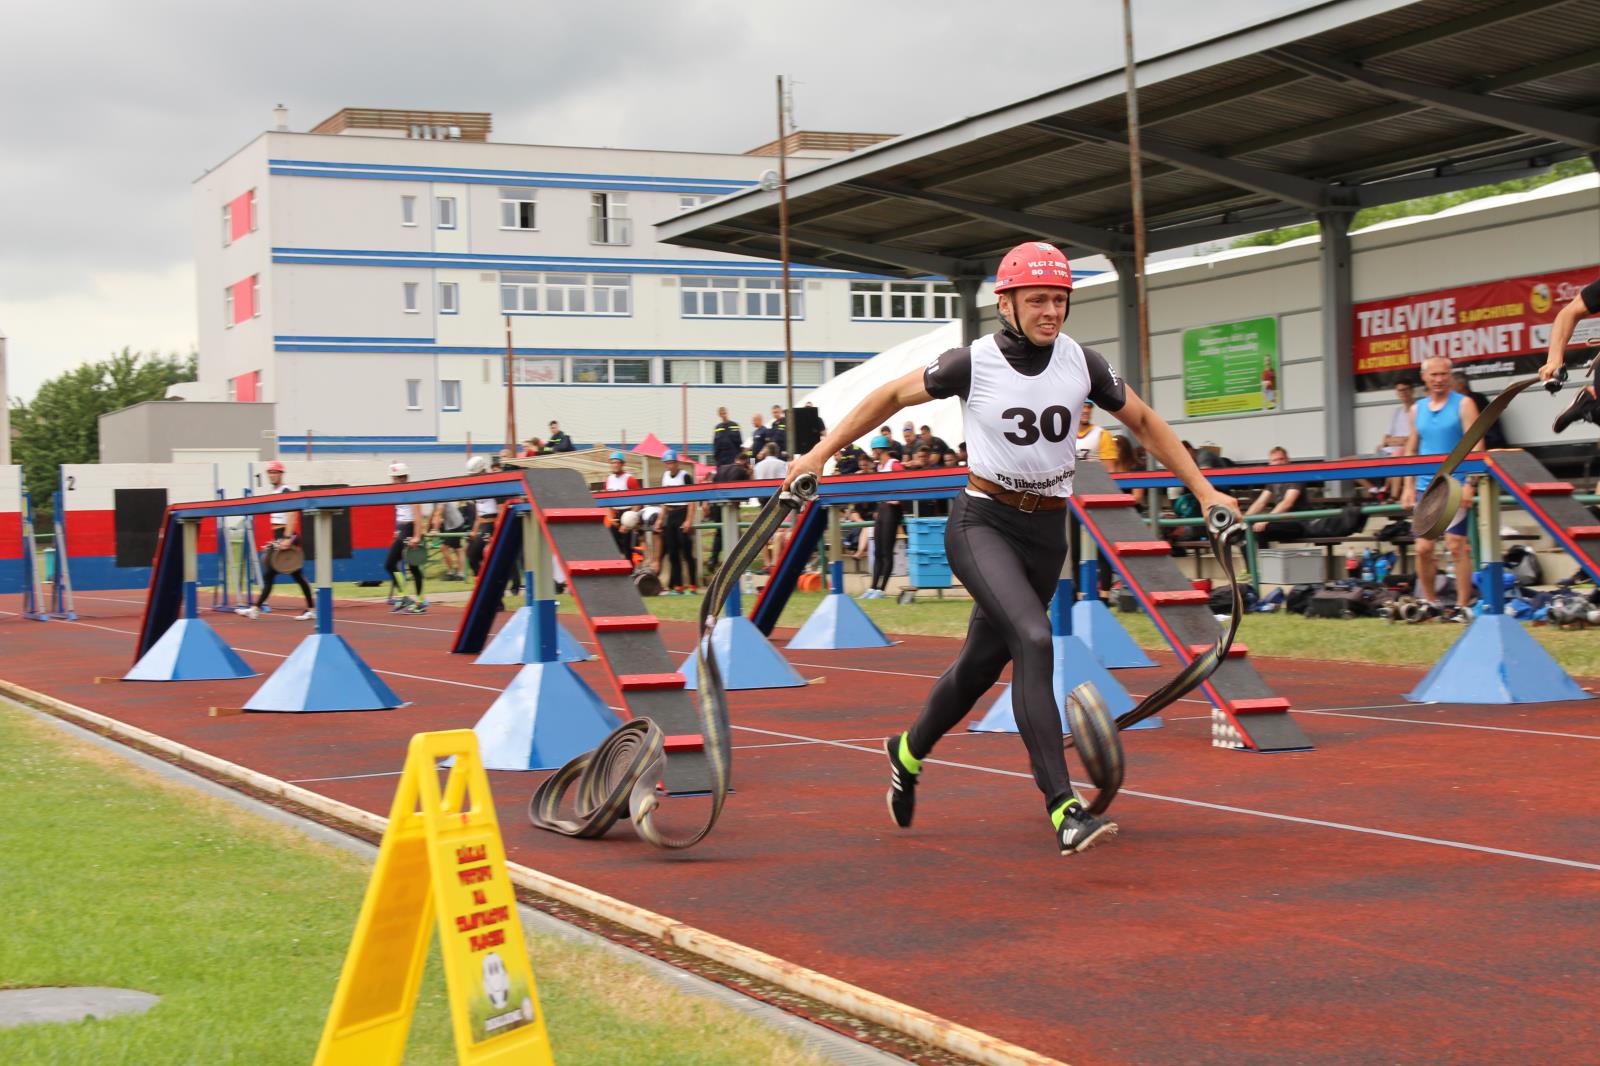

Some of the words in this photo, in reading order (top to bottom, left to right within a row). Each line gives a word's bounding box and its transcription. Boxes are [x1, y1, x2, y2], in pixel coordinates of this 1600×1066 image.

[1357, 297, 1456, 338] TELEVIZE
[1410, 322, 1525, 364] INTERNET
[1001, 405, 1072, 447] 30
[66, 475, 76, 491] 2
[254, 473, 262, 488] 1
